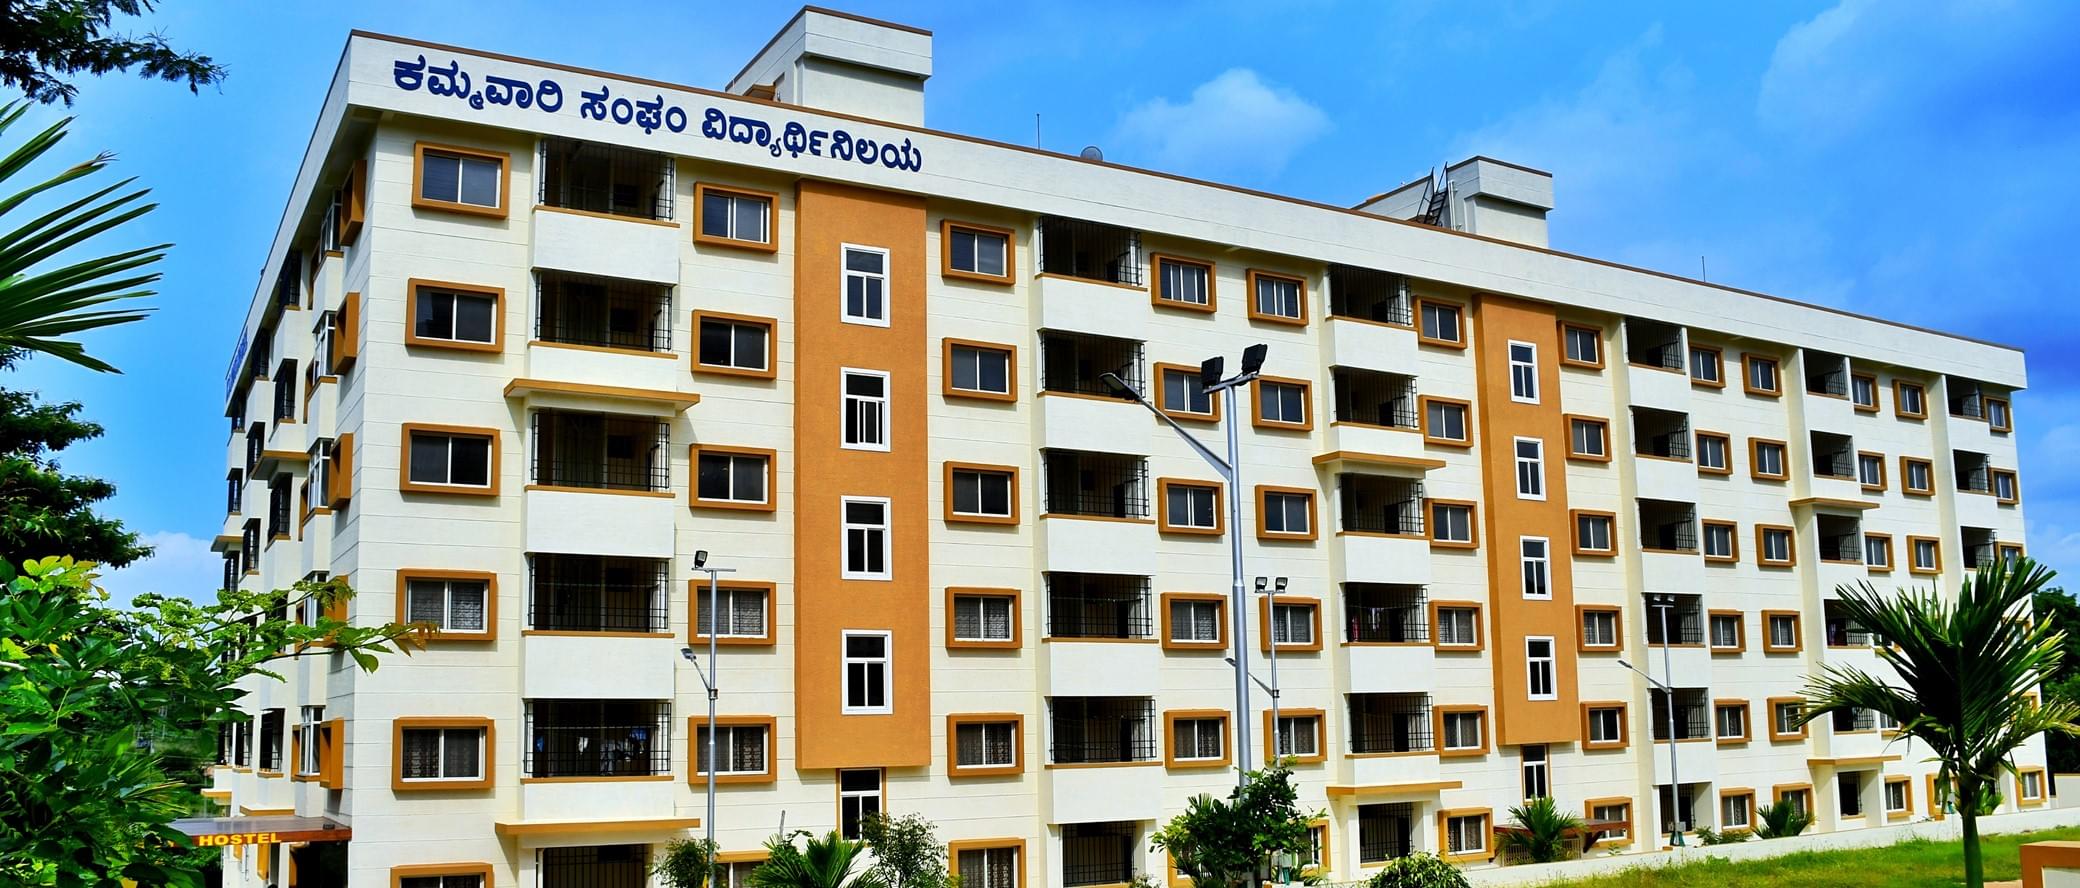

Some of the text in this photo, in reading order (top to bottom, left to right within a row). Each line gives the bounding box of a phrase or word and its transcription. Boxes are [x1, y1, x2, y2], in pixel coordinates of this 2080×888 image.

[393, 54, 922, 172] ಕಮ್ಮವಾರಿ ಸಂಘಂ ವಿದ್ಯಾರ್ಥಿನಿಲಯ
[199, 832, 282, 846] HOSTEL
